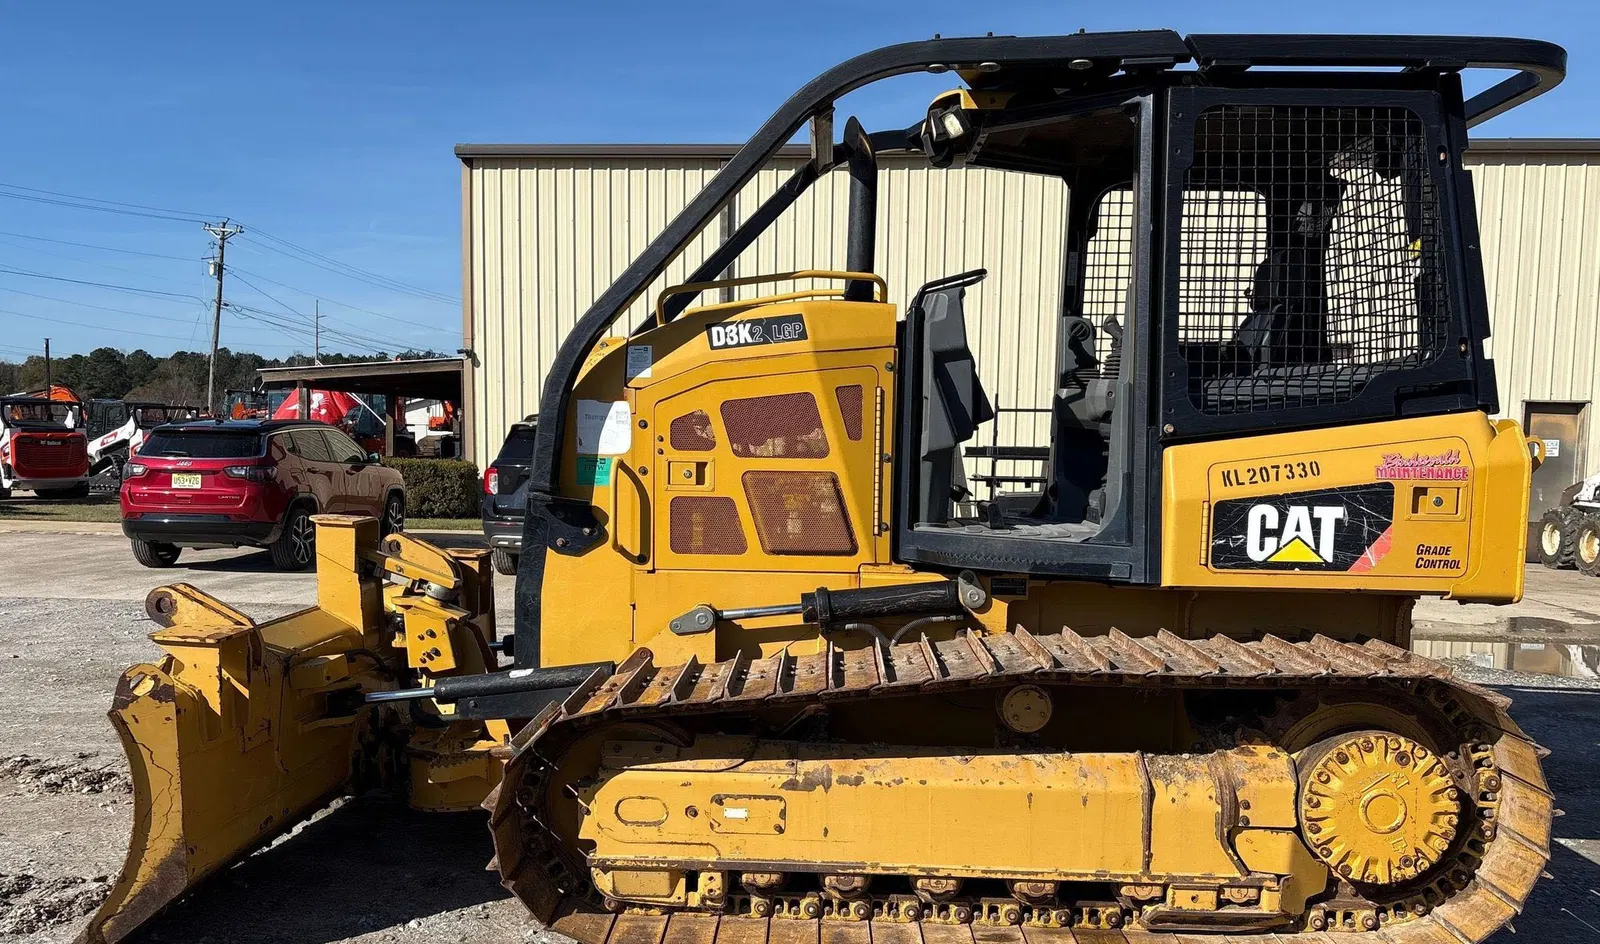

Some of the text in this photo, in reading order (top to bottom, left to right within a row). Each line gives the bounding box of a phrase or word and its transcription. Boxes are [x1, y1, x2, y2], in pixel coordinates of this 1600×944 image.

[771, 322, 803, 341] LGP
[1221, 460, 1321, 488] KL207330
[1375, 466, 1469, 480] MAINTENANCE
[1246, 503, 1344, 563] CAT
[1416, 543, 1452, 556] GRADE
[1415, 557, 1461, 570] CONTROL
